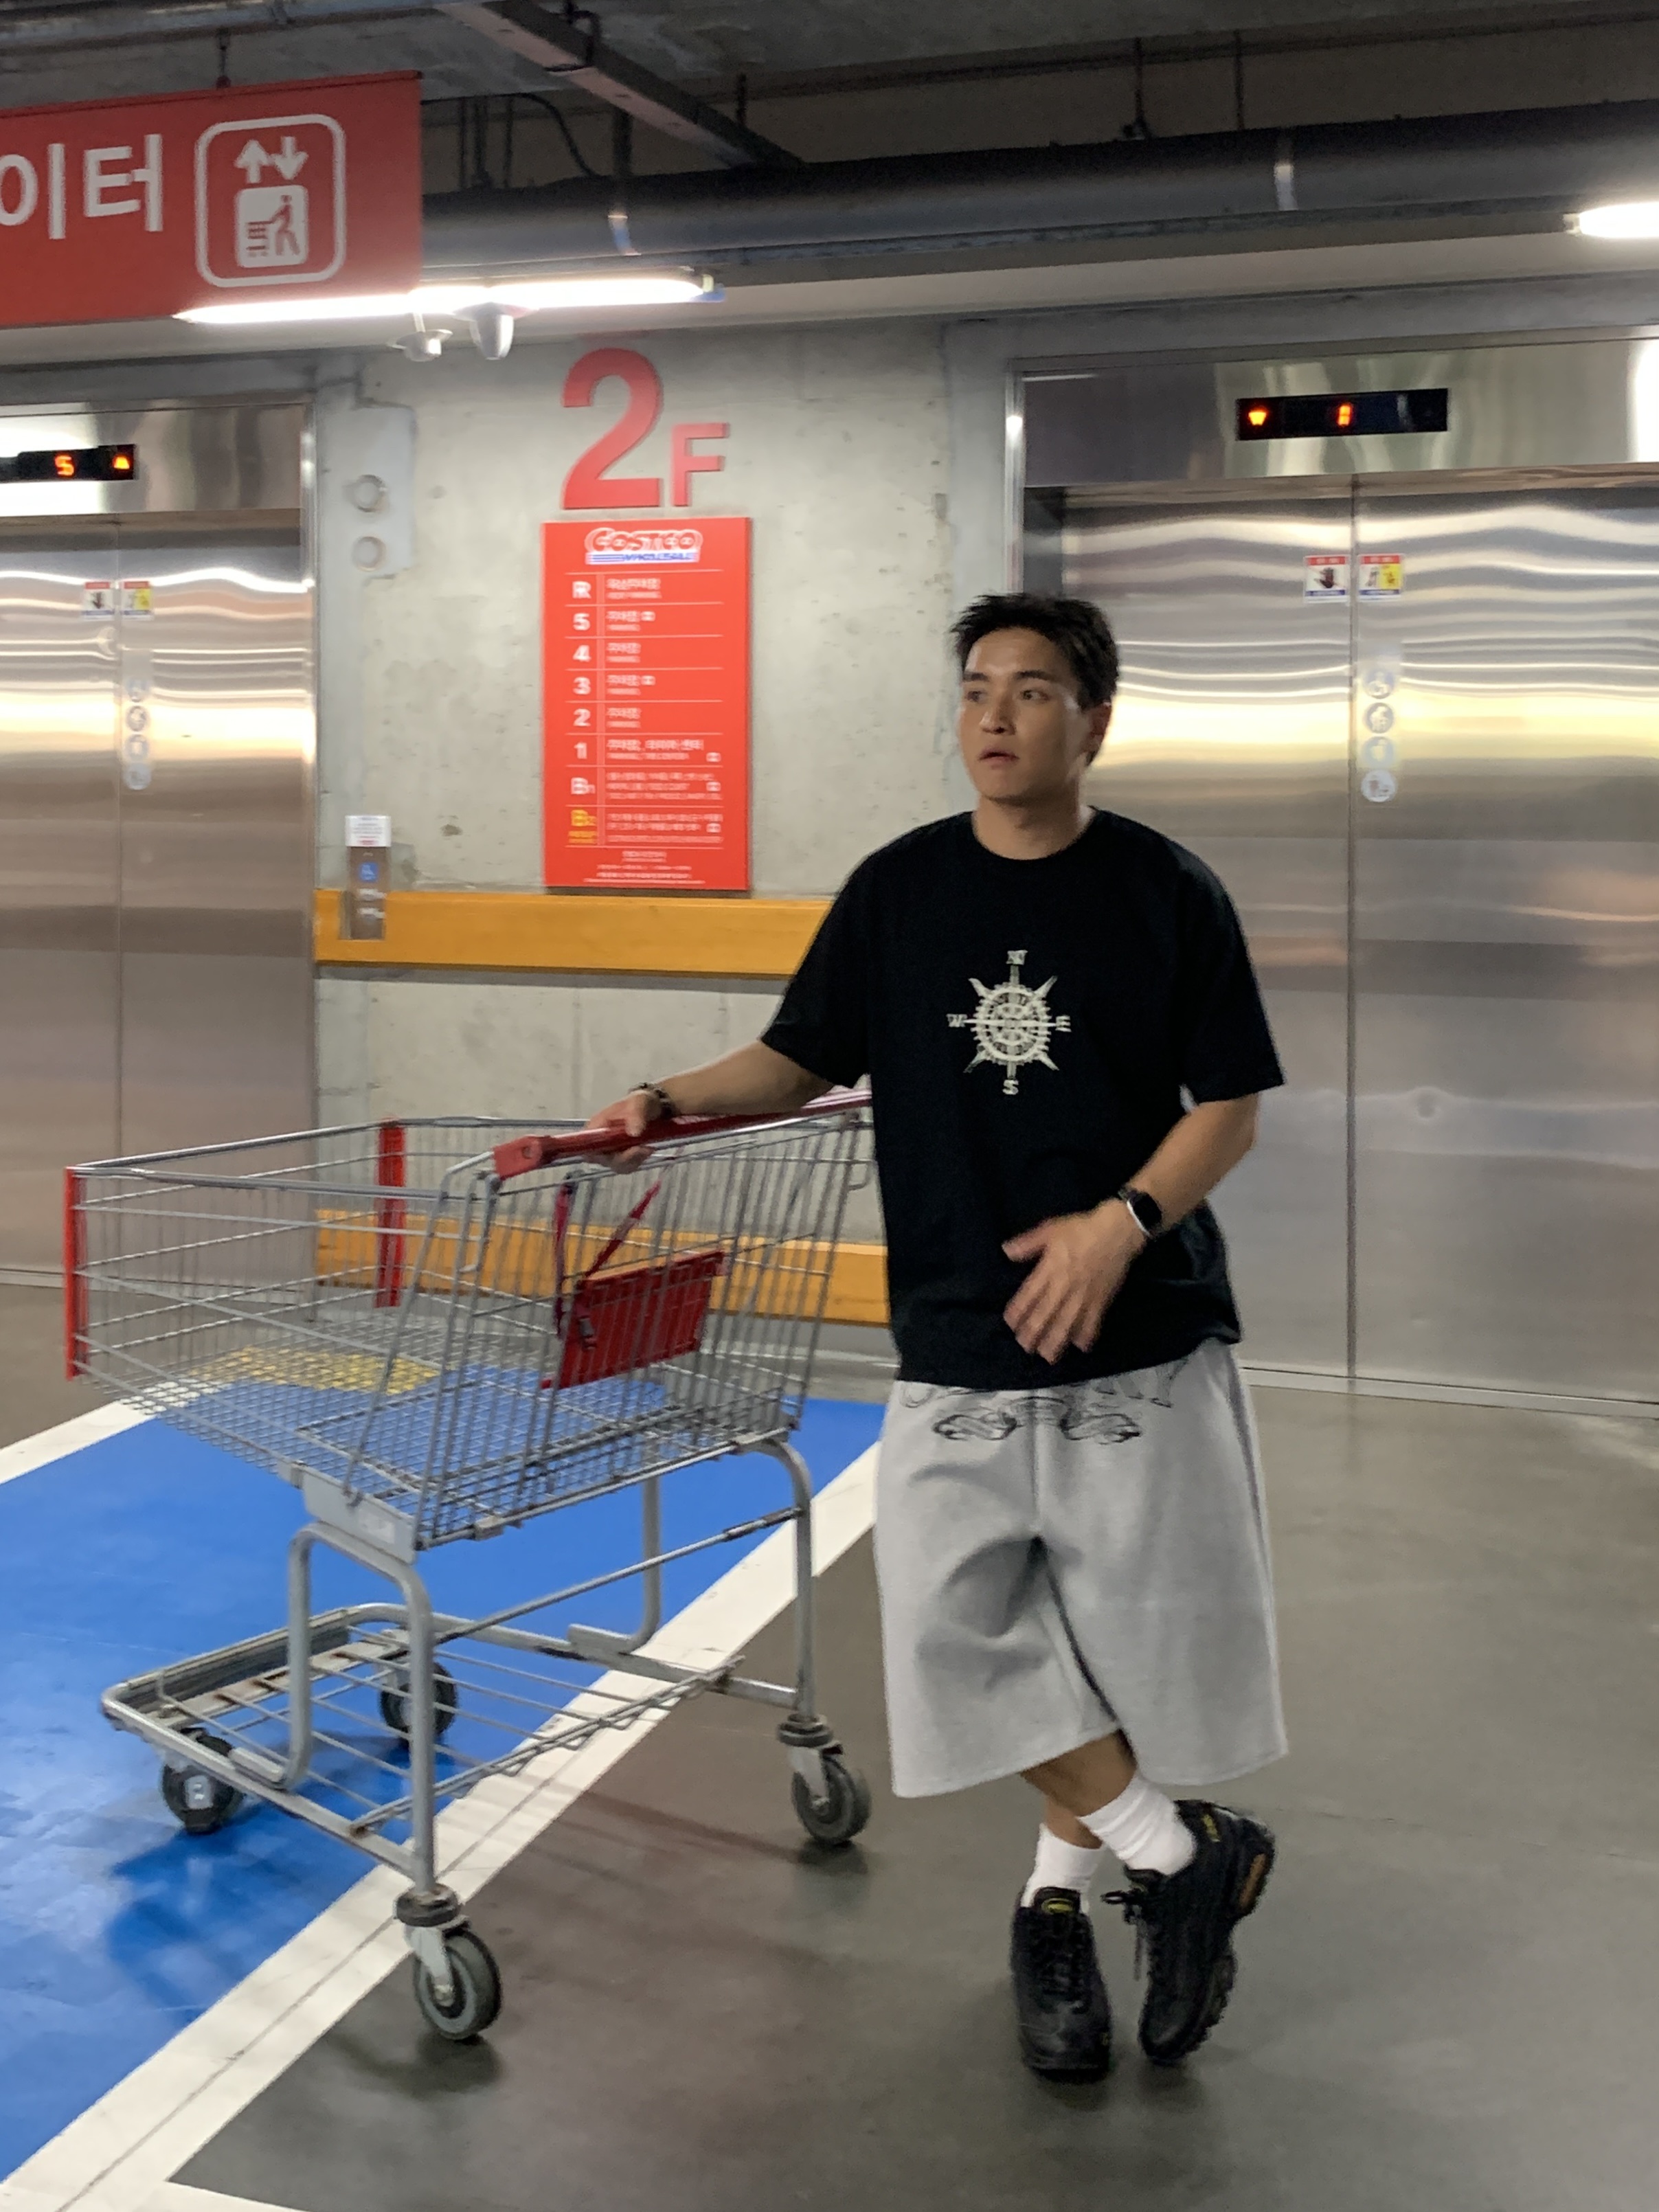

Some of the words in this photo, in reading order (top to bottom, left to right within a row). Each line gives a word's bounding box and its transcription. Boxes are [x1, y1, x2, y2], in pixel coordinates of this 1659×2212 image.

[562, 348, 730, 510] 2F
[584, 527, 703, 552] COSTCO
[572, 580, 591, 598] R
[573, 613, 591, 631] 5
[572, 645, 591, 662] 4
[573, 677, 591, 695] 3
[573, 708, 591, 726] 2
[574, 742, 587, 759] 1
[1056, 1015, 1072, 1032] E
[1002, 1079, 1019, 1095] S
